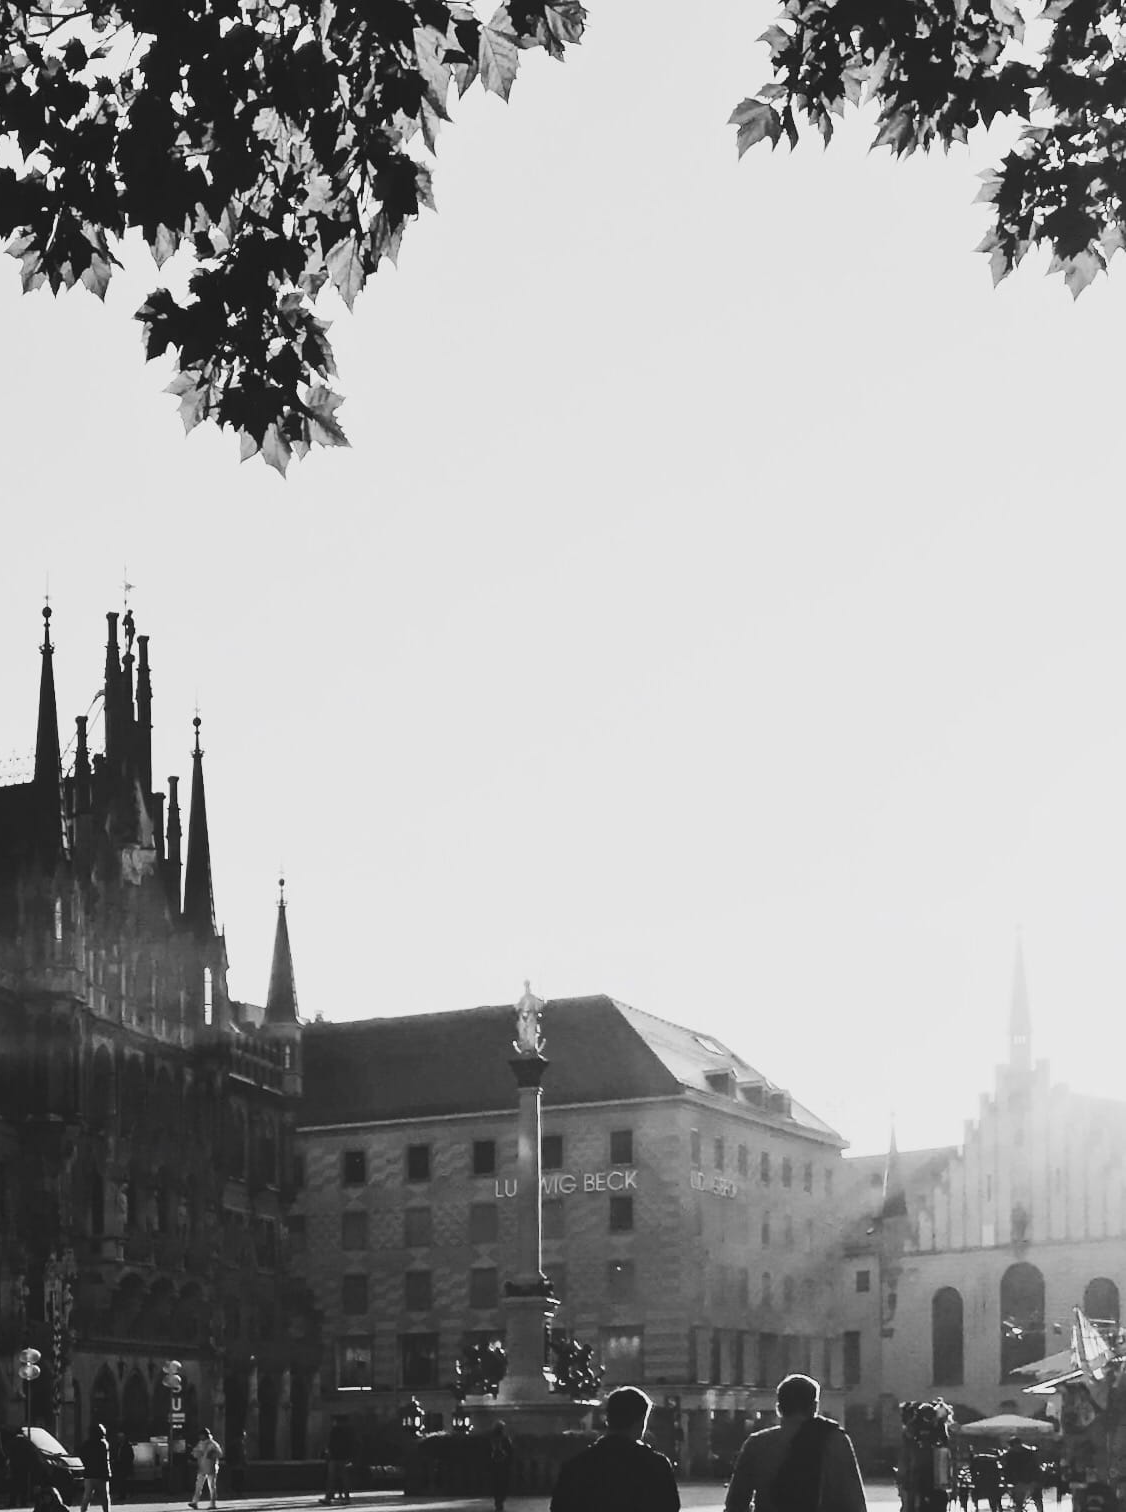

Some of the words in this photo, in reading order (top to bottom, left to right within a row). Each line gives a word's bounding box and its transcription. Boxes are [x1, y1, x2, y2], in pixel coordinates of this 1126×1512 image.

[495, 1174, 577, 1198] LUWIG
[582, 1170, 638, 1192] BECK
[171, 1397, 182, 1411] U
